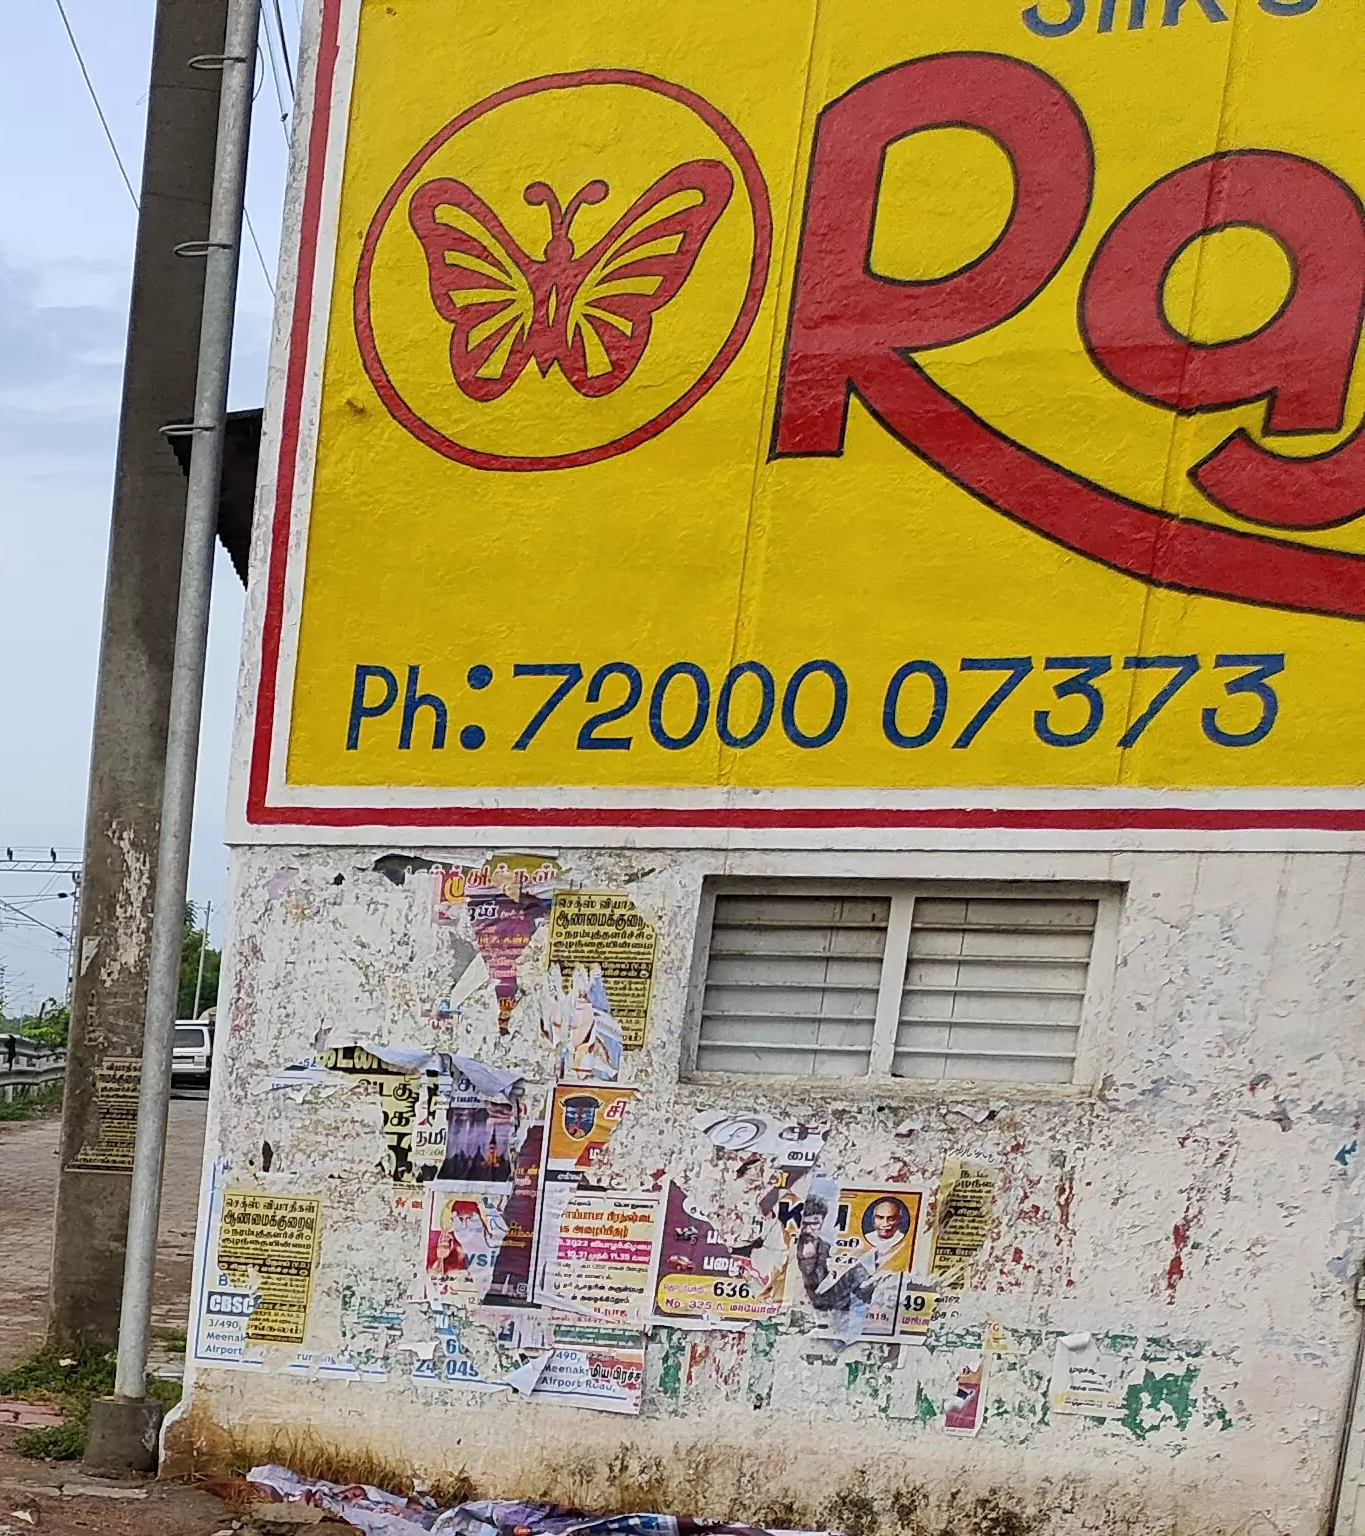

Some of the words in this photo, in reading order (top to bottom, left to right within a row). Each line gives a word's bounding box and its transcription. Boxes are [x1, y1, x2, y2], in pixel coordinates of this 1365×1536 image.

[346, 659, 850, 752] Ph:72000
[881, 653, 1286, 750] 07373
[713, 1281, 756, 1300] 636
[206, 1331, 247, 1343] Meenak
